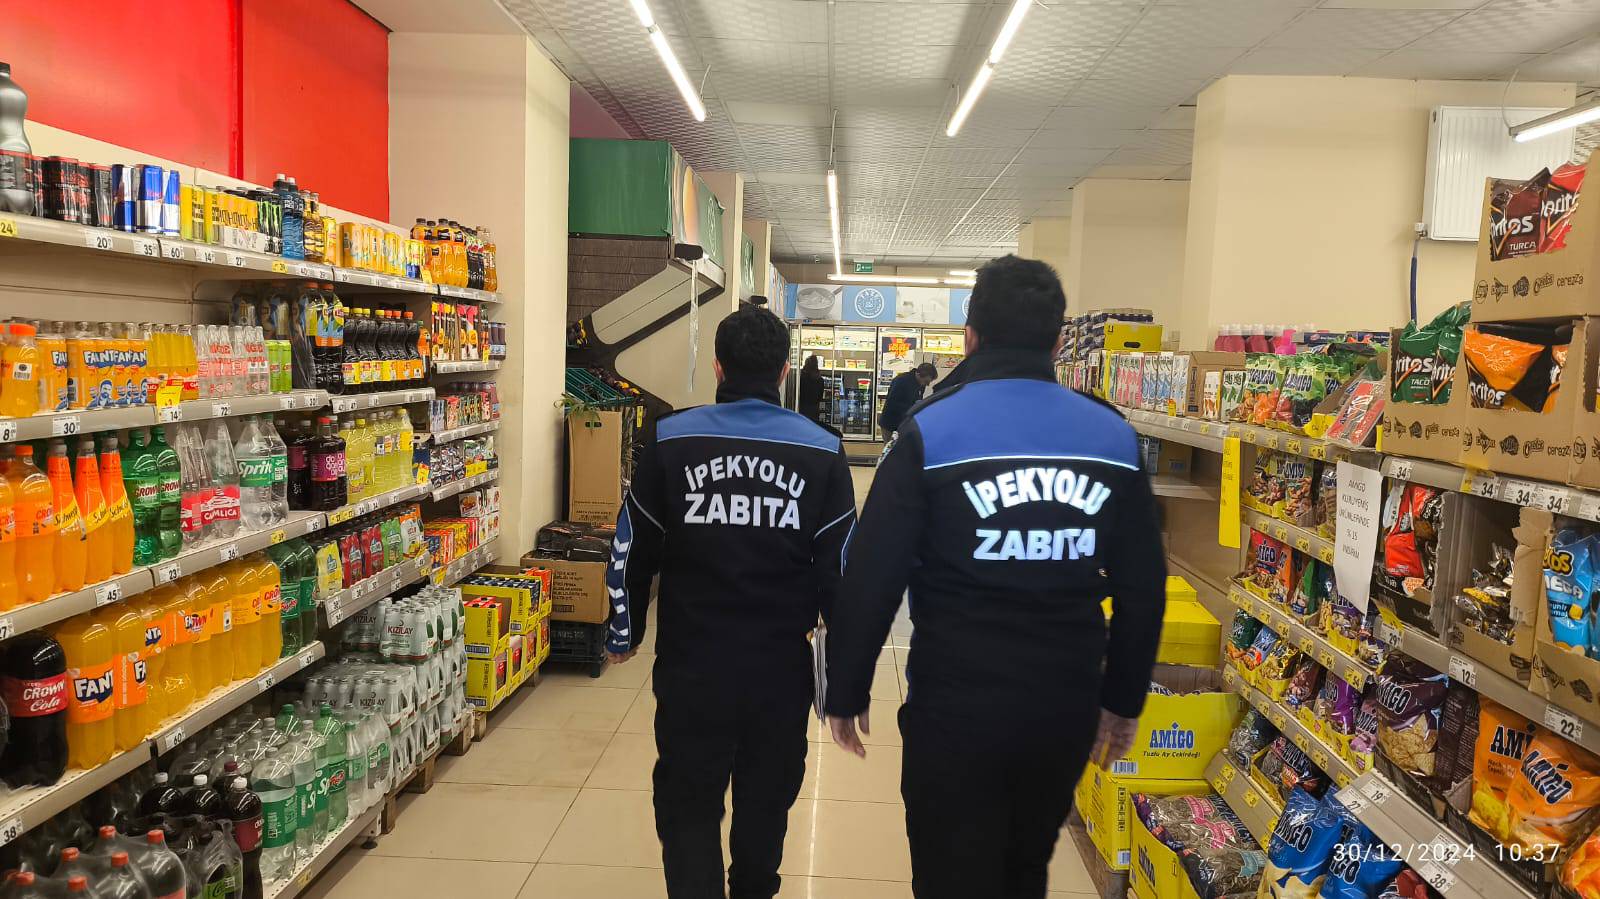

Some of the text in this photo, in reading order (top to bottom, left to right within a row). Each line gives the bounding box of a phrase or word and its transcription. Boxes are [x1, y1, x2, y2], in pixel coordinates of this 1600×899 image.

[96, 237, 108, 249] 20
[1509, 241, 1537, 251] TURCA
[63, 422, 76, 435] 30
[238, 460, 272, 478] Sprit
[684, 454, 806, 499] İPEKYOLU
[962, 468, 1112, 519] İPEKYOLU
[1481, 481, 1494, 497] 34
[1515, 489, 1530, 506] 34
[684, 493, 801, 530] ZABITA
[1547, 495, 1563, 513] 34
[973, 528, 1096, 561] ZABITA
[168, 569, 178, 580] 23
[107, 589, 118, 601] 45
[1462, 668, 1471, 685] 12
[23, 678, 65, 701] CROWN
[30, 696, 61, 712] Cola
[1149, 722, 1194, 749] AMİGO
[1560, 718, 1575, 738] 22
[4, 827, 17, 843] 38
[1429, 874, 1447, 889] 38
